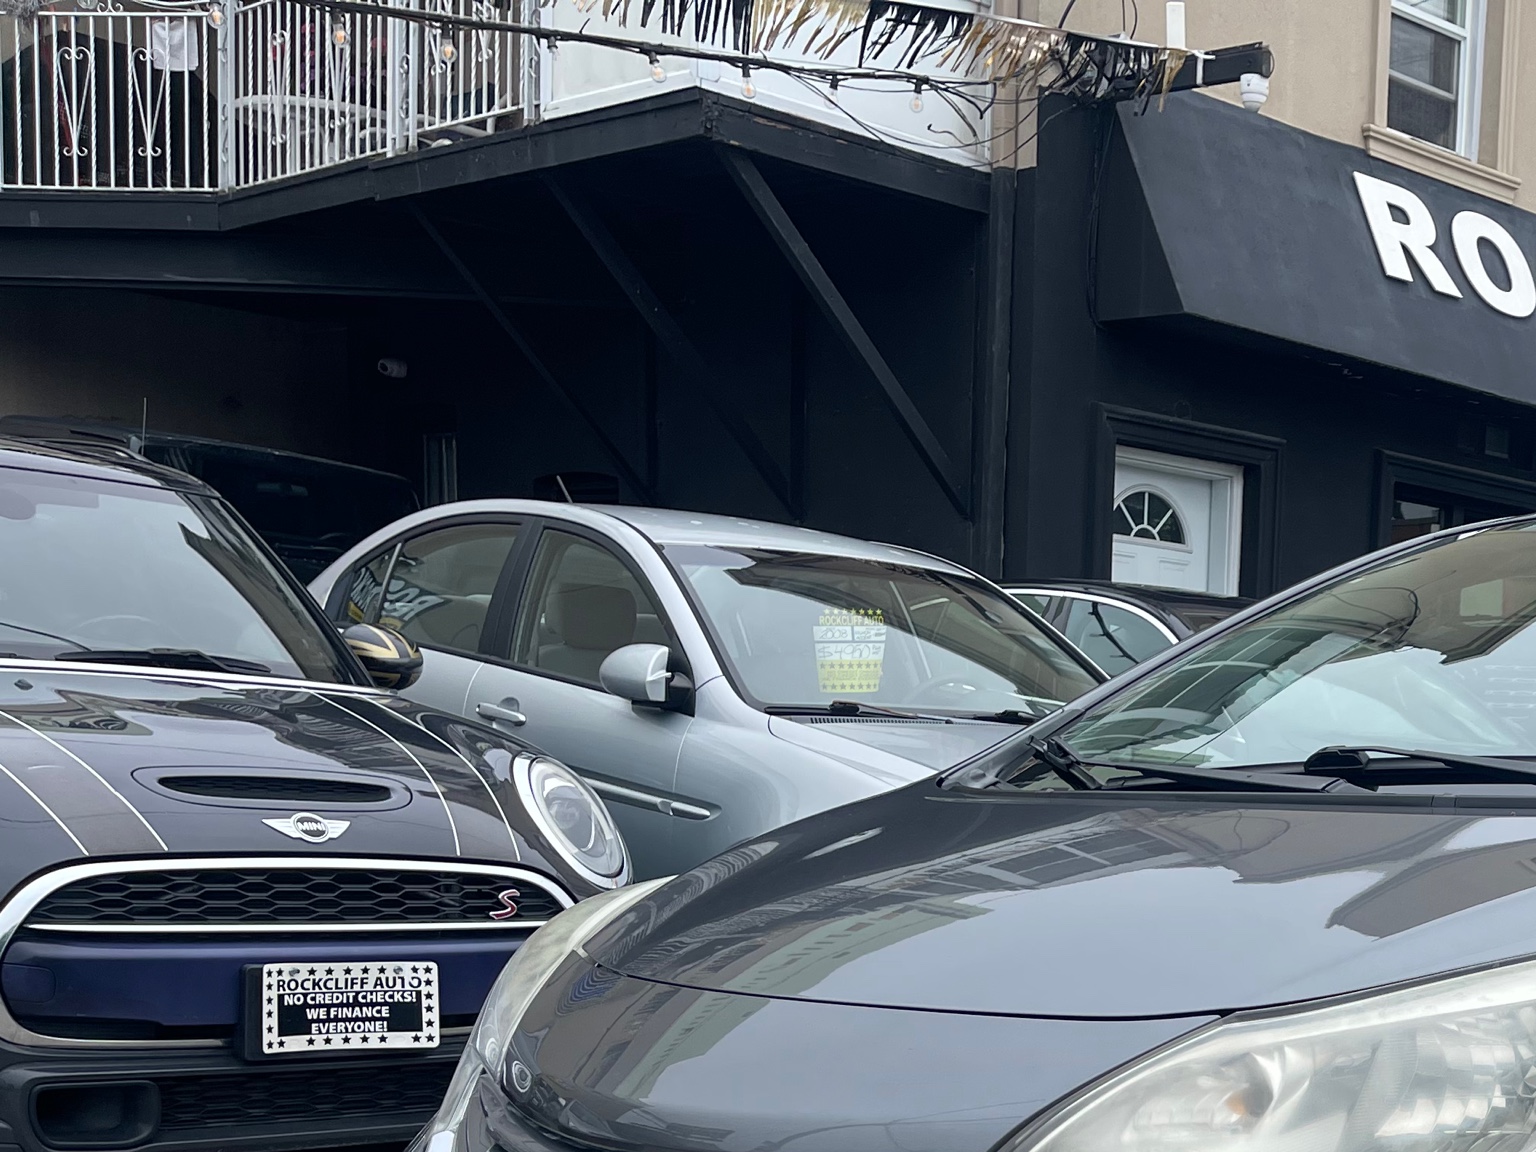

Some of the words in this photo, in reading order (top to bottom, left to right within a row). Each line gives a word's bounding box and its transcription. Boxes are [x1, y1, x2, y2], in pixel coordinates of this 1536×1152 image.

[819, 615, 863, 626] ROCKCLIFF
[864, 615, 884, 626] AUTO
[297, 821, 326, 831] MINI
[489, 888, 521, 921] S
[276, 976, 370, 992] ROCKCLIFF
[283, 994, 304, 1006] NO
[306, 992, 355, 1005] CREDIT
[358, 991, 417, 1004] CHECKS!
[306, 1008, 327, 1020] WE
[330, 1006, 390, 1019] FINANCE
[311, 1021, 388, 1034] EVERYONE!
